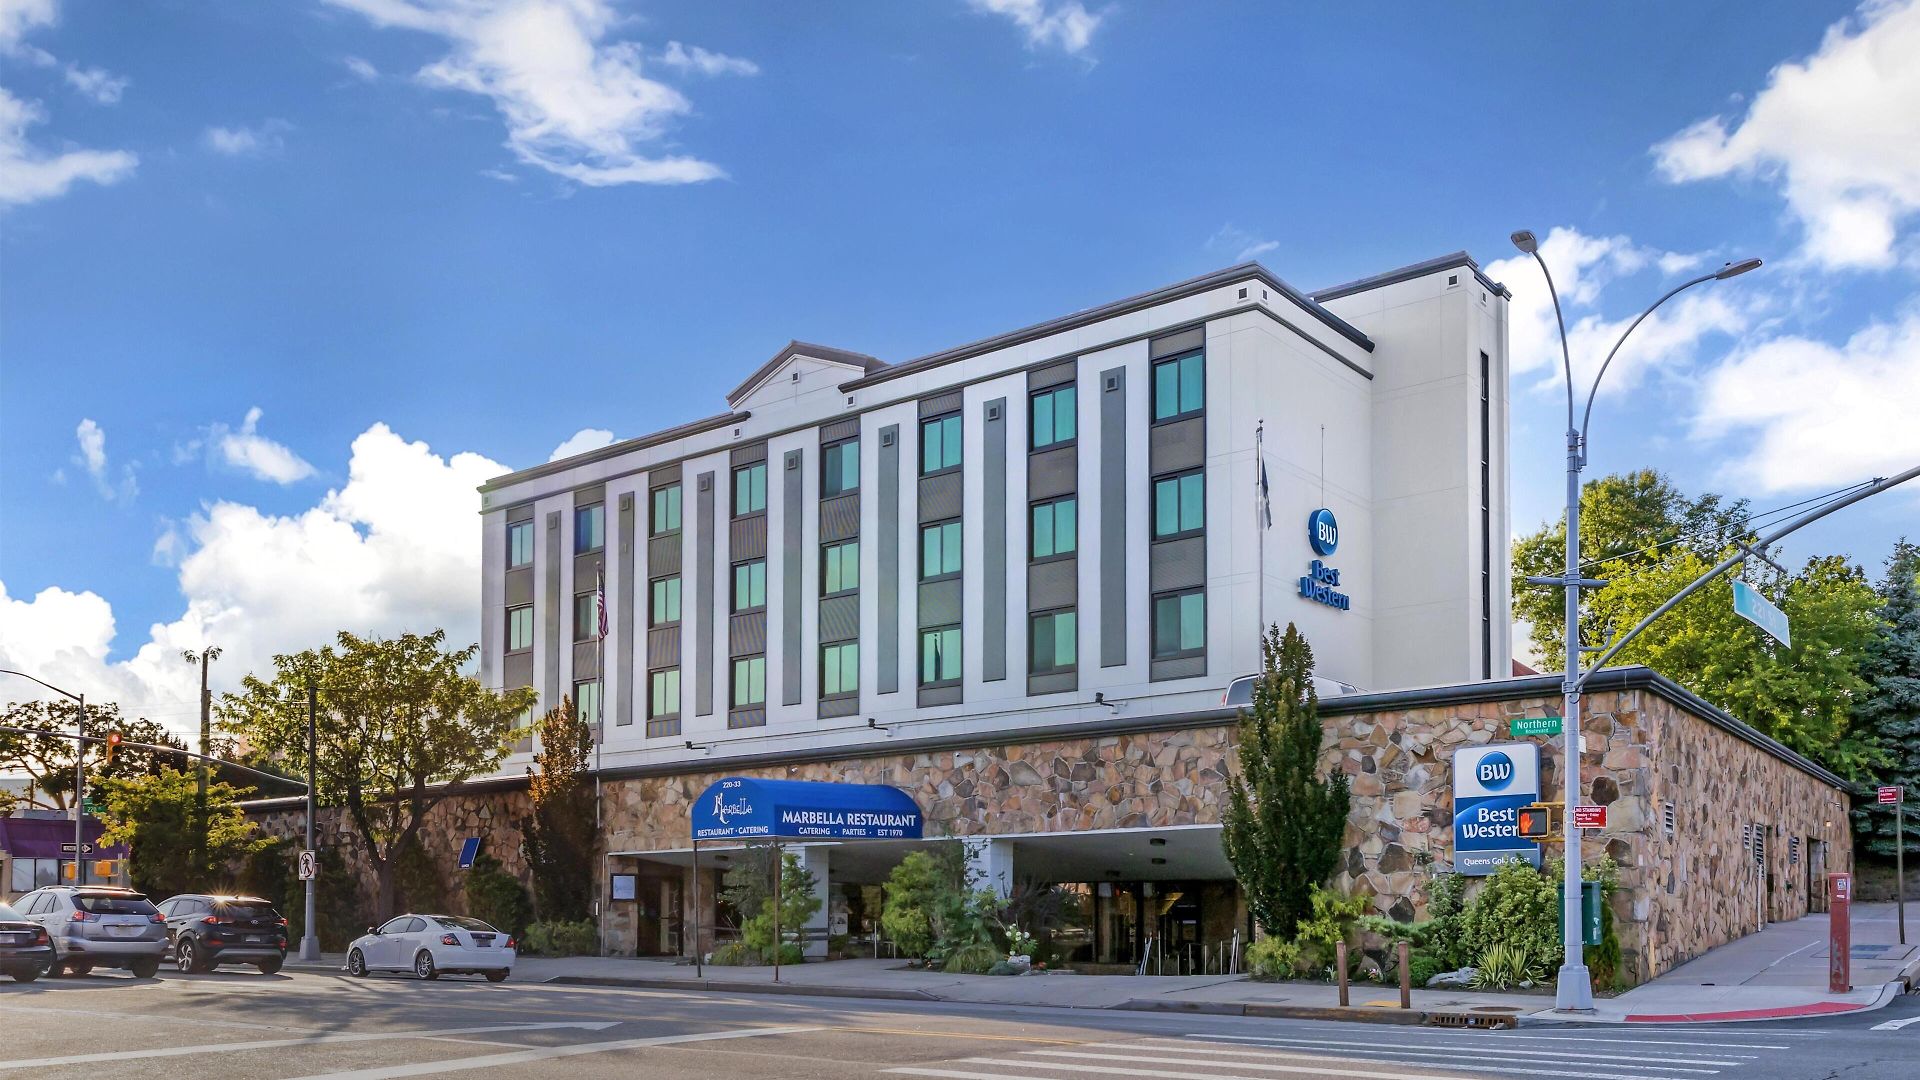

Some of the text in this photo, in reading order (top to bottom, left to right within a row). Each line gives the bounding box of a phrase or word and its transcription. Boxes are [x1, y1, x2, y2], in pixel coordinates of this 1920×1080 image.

[1318, 521, 1337, 545] BW
[1311, 559, 1340, 586] Best
[1300, 577, 1350, 610] Western
[1516, 719, 1557, 730] Northern
[1480, 762, 1511, 781] BW
[782, 811, 917, 827] MARBELLA RESTAURANT
[1478, 808, 1514, 822] Best
[697, 825, 769, 837] RESTAURANT CATERING
[798, 827, 903, 837] CATERING PARTIES EST 1970
[1462, 823, 1519, 839] Wester
[1463, 857, 1491, 866] Queens
